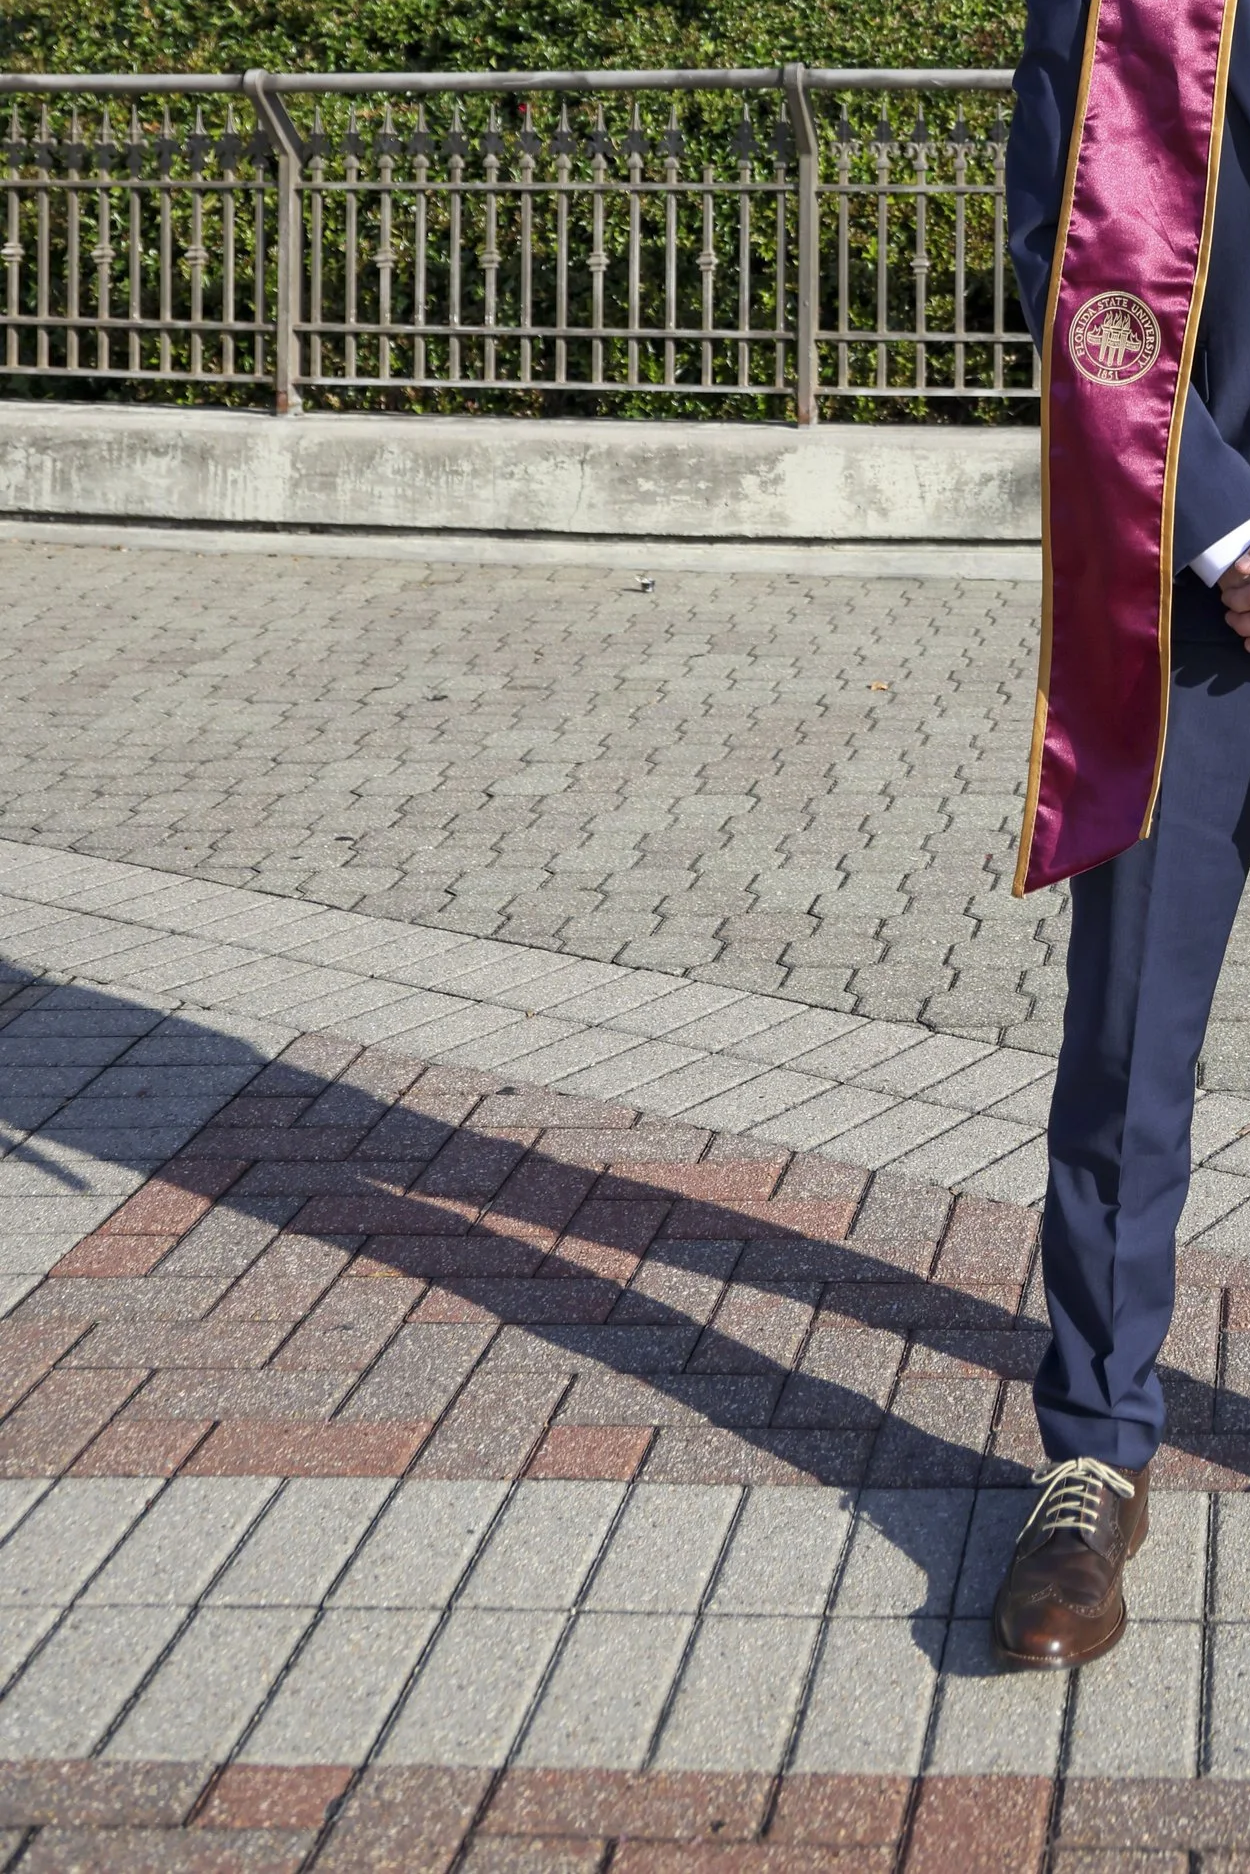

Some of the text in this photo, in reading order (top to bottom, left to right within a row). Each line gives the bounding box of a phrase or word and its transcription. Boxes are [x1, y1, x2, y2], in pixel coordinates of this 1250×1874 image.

[1074, 297, 1155, 368] FLORIDA STATE UNIVERSITY
[1098, 368, 1120, 380] 1851
